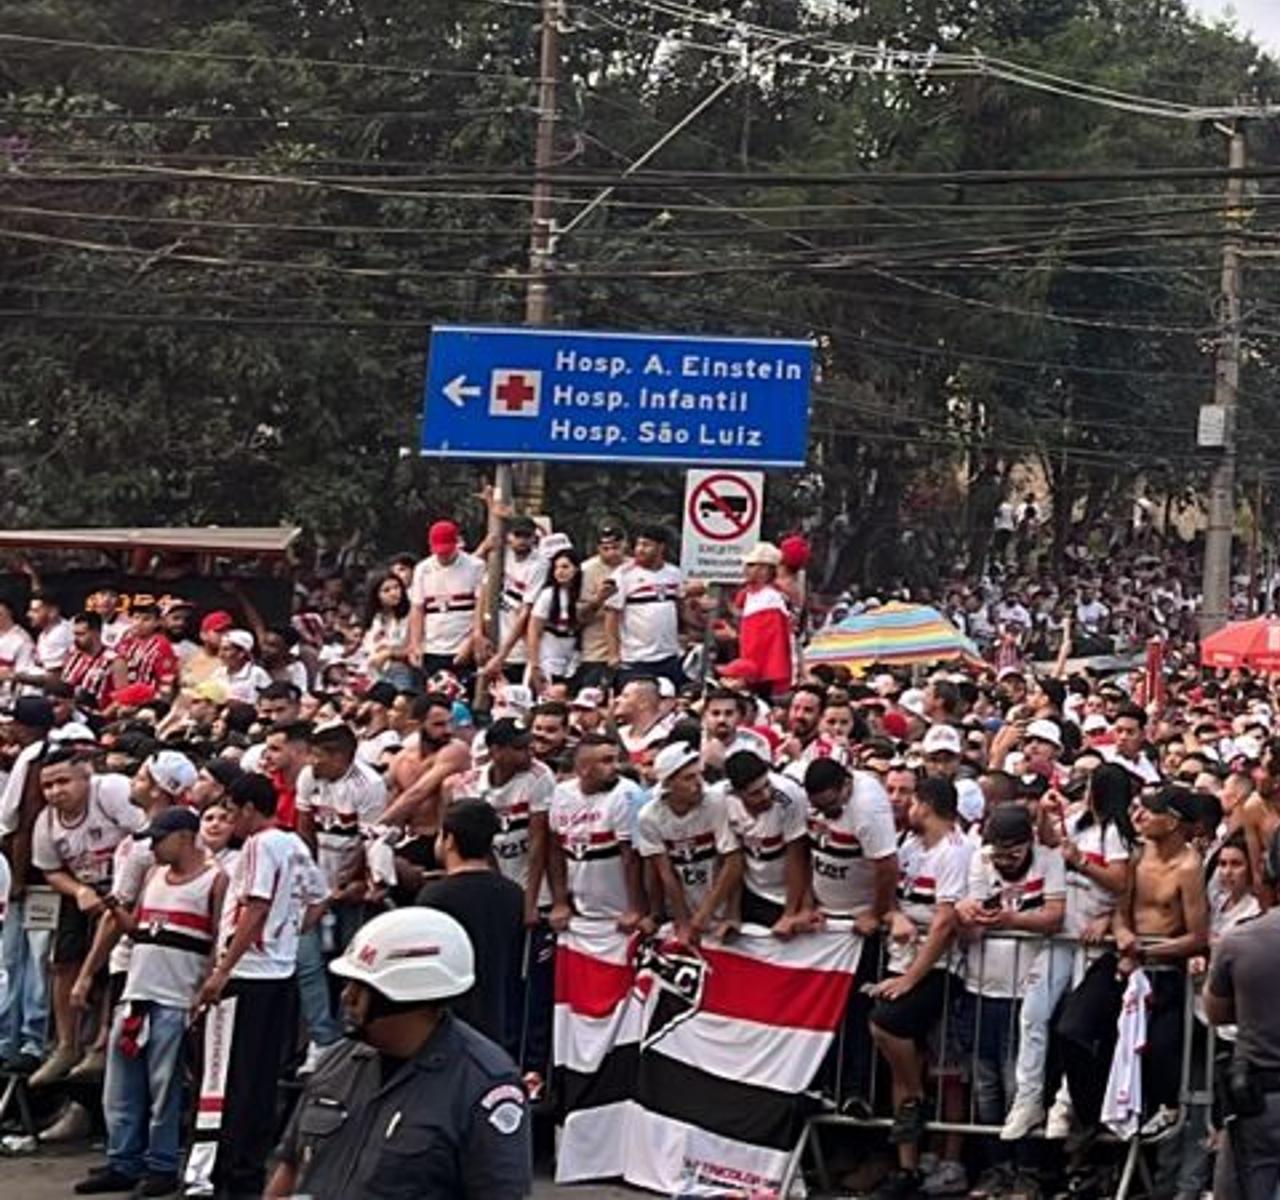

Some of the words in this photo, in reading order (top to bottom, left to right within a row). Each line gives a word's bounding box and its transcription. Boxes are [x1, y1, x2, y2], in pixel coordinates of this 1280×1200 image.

[555, 350, 632, 379] Hosp.
[643, 354, 672, 377] A.
[682, 355, 801, 380] Einstein
[553, 386, 630, 410] Hosp.
[639, 388, 748, 412] Infantil
[550, 419, 627, 445] Hosp.
[638, 421, 689, 445] São
[699, 424, 763, 447] Luiz
